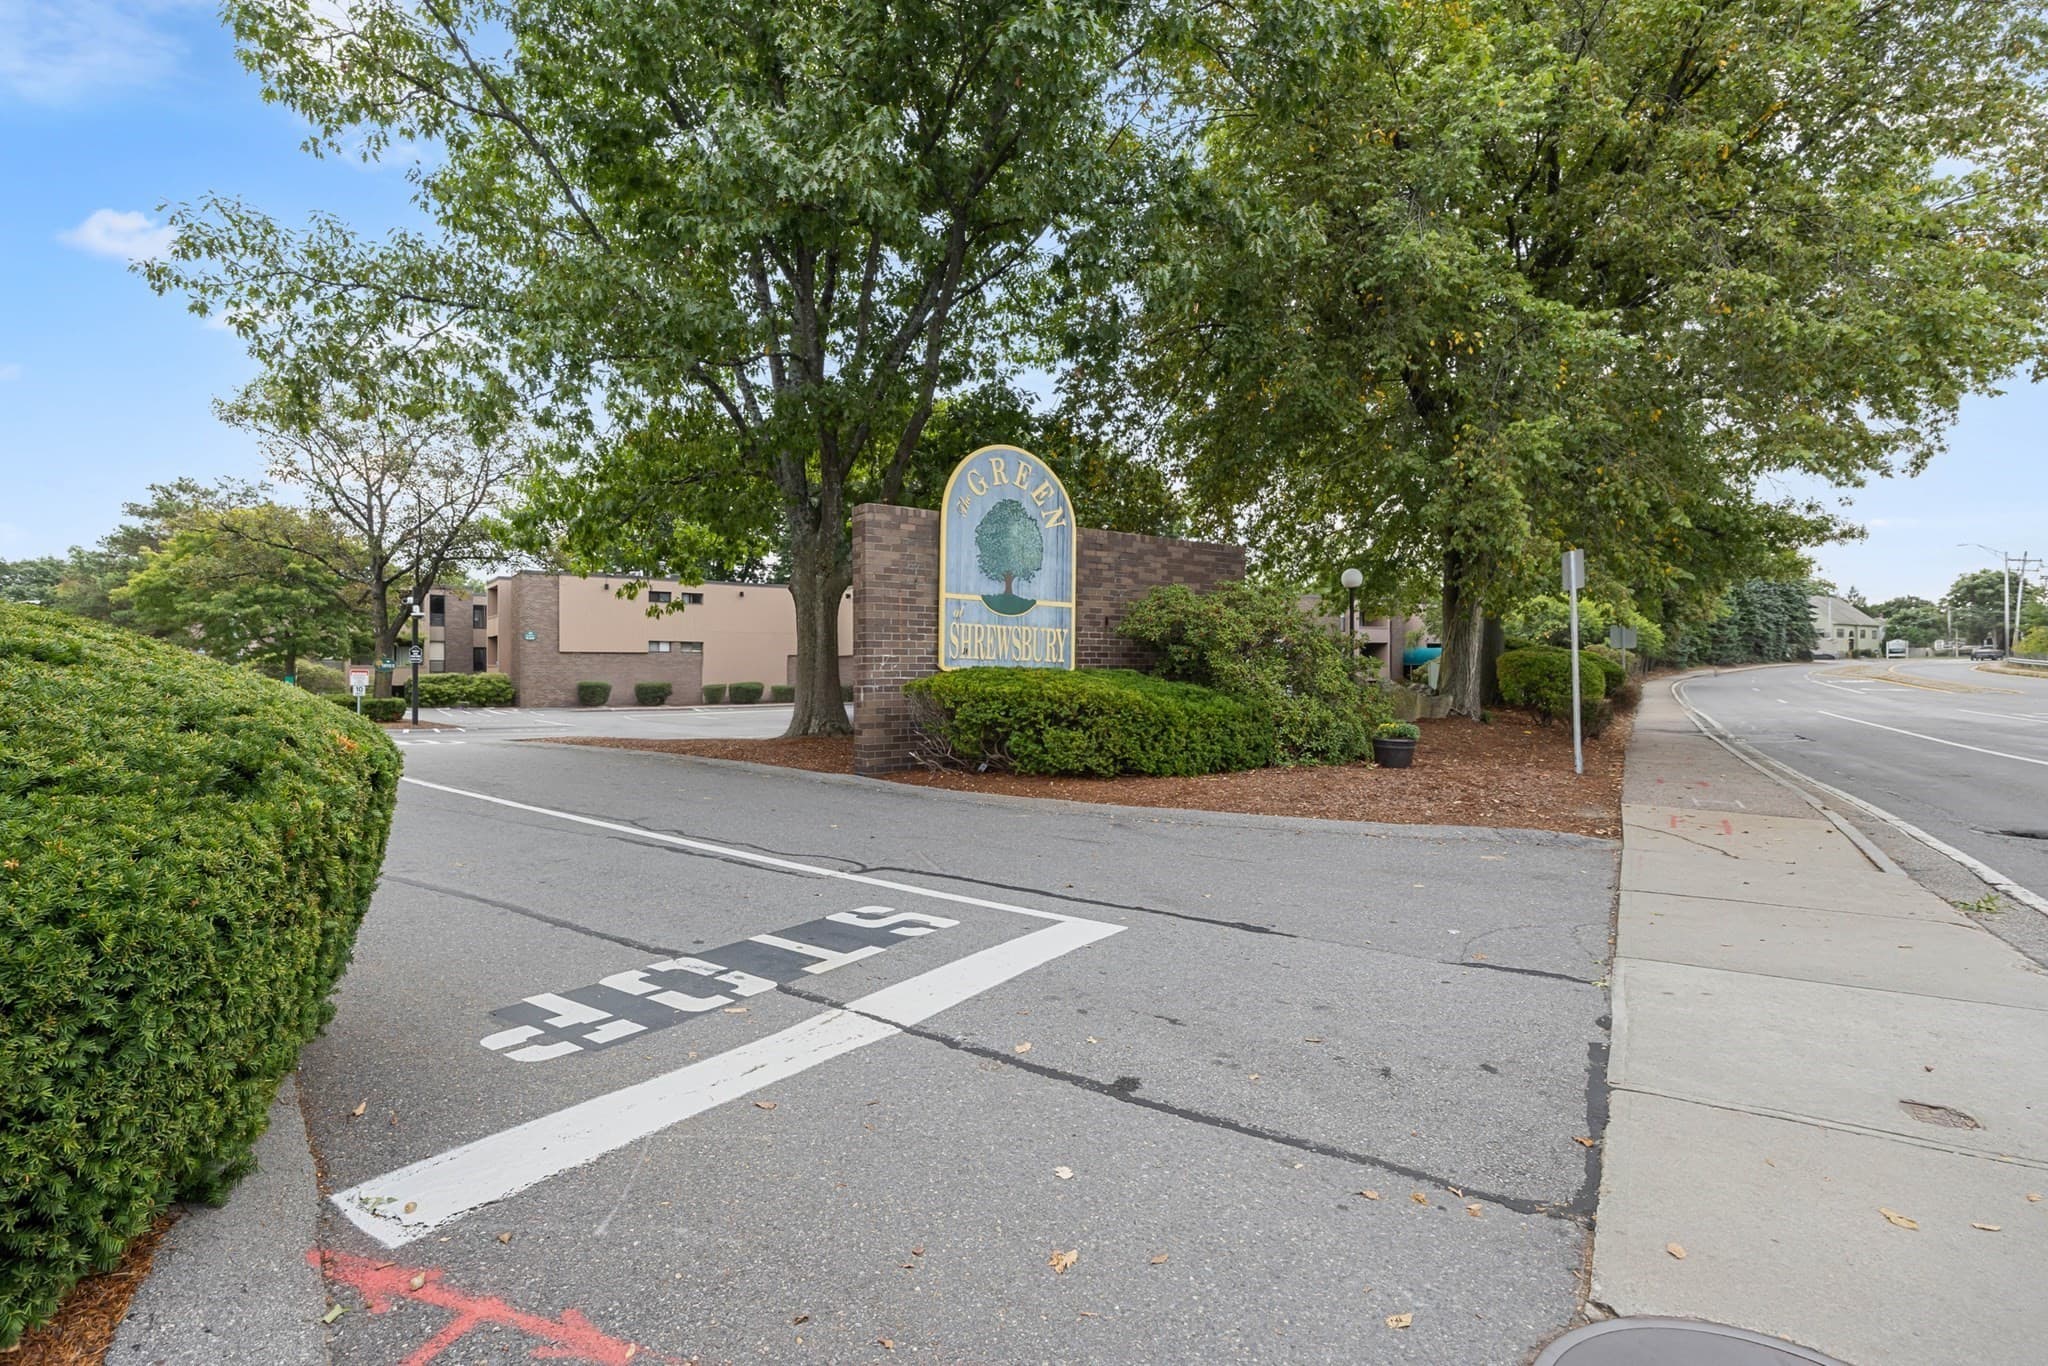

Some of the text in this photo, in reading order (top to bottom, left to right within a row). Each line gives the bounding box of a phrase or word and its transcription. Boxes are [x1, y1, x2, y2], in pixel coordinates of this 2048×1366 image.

[967, 457, 1067, 529] GREEN
[949, 622, 1069, 663] SHREWSBURY
[479, 905, 961, 1062] STOP
